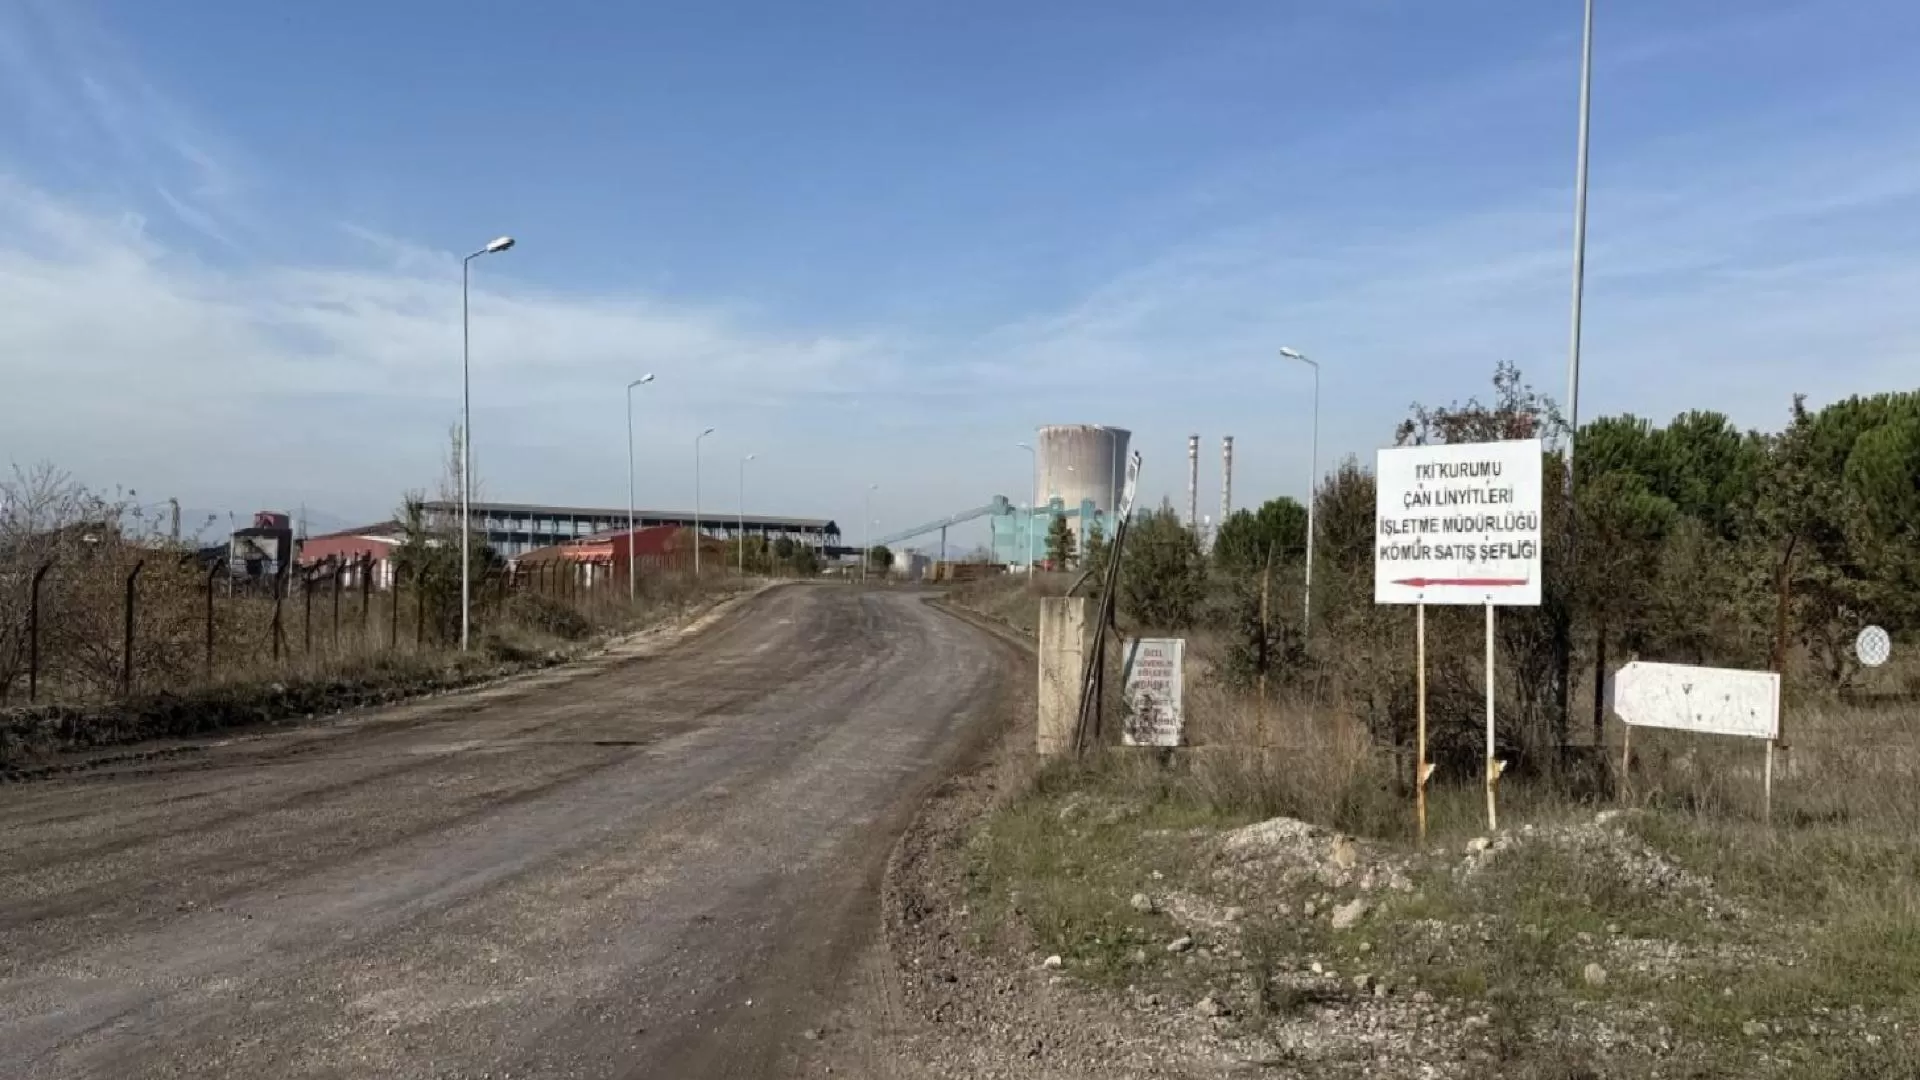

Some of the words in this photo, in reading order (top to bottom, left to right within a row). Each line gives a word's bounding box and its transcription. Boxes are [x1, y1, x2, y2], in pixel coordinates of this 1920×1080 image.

[1438, 460, 1502, 478] KURUMU
[1404, 490, 1431, 509] ÇAN
[1435, 484, 1513, 505] LİNYİTLERİ
[1380, 516, 1439, 536] İŞLETME
[1443, 511, 1537, 533] MÜDÜRLÜĞÜ
[1380, 542, 1431, 560] KÖMÜR
[1434, 544, 1476, 563] SATIŞ
[1480, 540, 1537, 564] ŞEFLİĞİ
